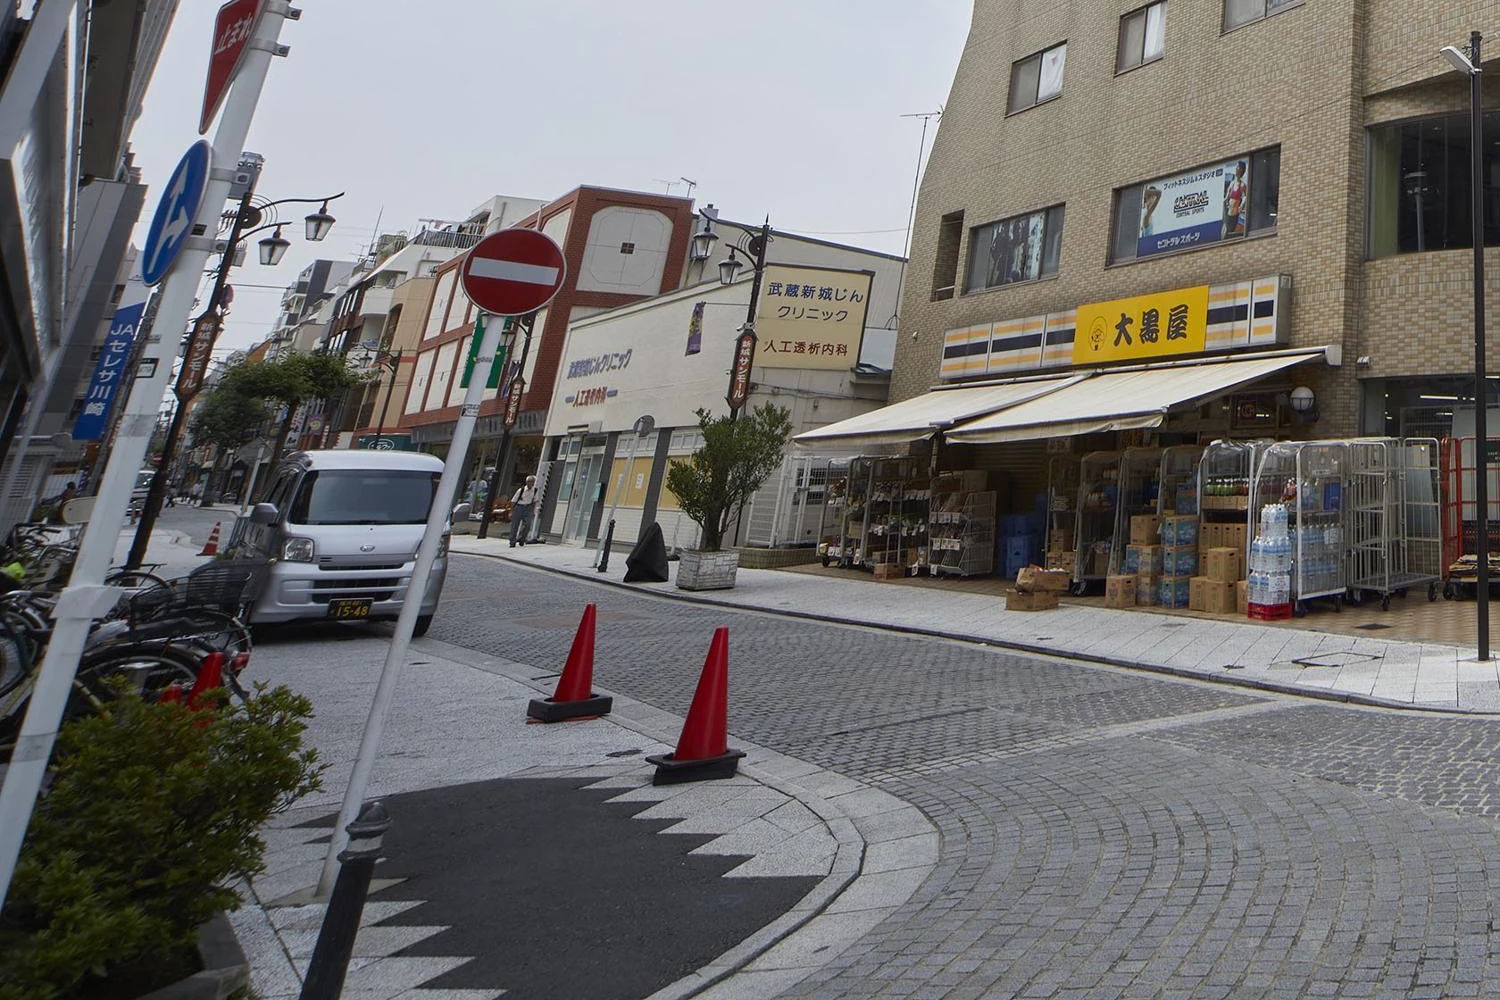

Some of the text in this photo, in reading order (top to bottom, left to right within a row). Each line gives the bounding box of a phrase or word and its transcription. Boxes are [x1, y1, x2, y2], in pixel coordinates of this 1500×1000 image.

[213, 12, 253, 56] 止まれ
[767, 282, 864, 303] 武蔵新城じん
[777, 305, 849, 322] クリニック
[1113, 303, 1189, 347] 大黒屋
[763, 340, 848, 356] 人工透析内科
[84, 323, 134, 417] JAセレサ川崎
[733, 335, 753, 399] 新城サンモール
[336, 605, 369, 617] 15-48
